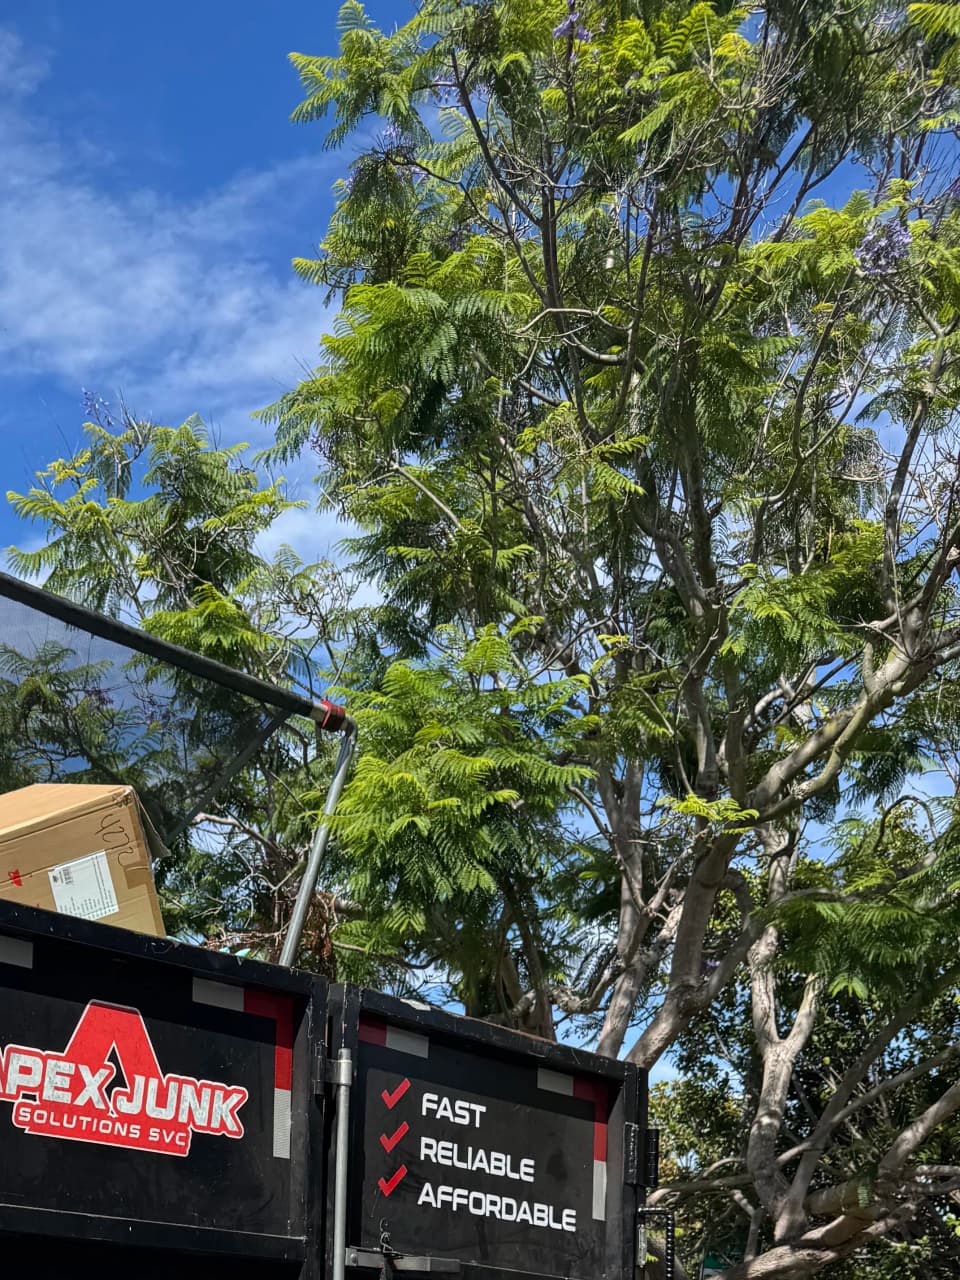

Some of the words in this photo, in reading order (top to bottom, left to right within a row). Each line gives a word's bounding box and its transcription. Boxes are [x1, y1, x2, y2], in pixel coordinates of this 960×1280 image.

[18, 1106, 141, 1138] SOLUTIONS
[148, 1127, 187, 1147] SVC
[116, 1074, 246, 1134] JUNK
[421, 1092, 487, 1128] FAST
[420, 1136, 535, 1183] RELIABLE
[417, 1182, 577, 1232] AFFORDABLE
